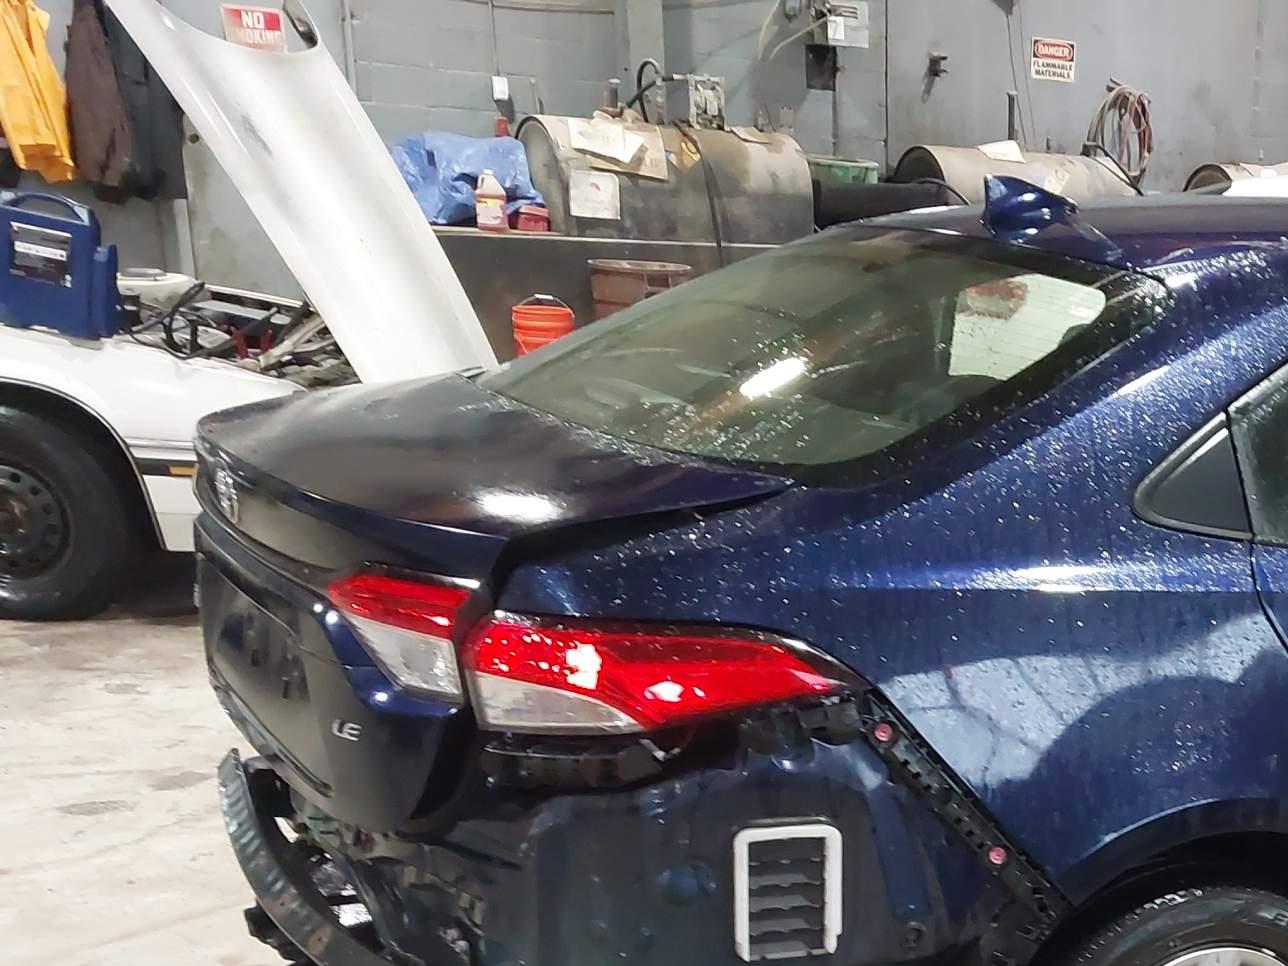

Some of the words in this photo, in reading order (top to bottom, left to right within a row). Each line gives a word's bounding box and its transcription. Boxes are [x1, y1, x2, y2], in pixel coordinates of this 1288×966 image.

[241, 10, 265, 29] NO
[1038, 44, 1070, 57] DANGER
[1033, 60, 1072, 71] FLAMMABLE
[1035, 69, 1071, 79] MATERIALS
[332, 719, 362, 741] LE
